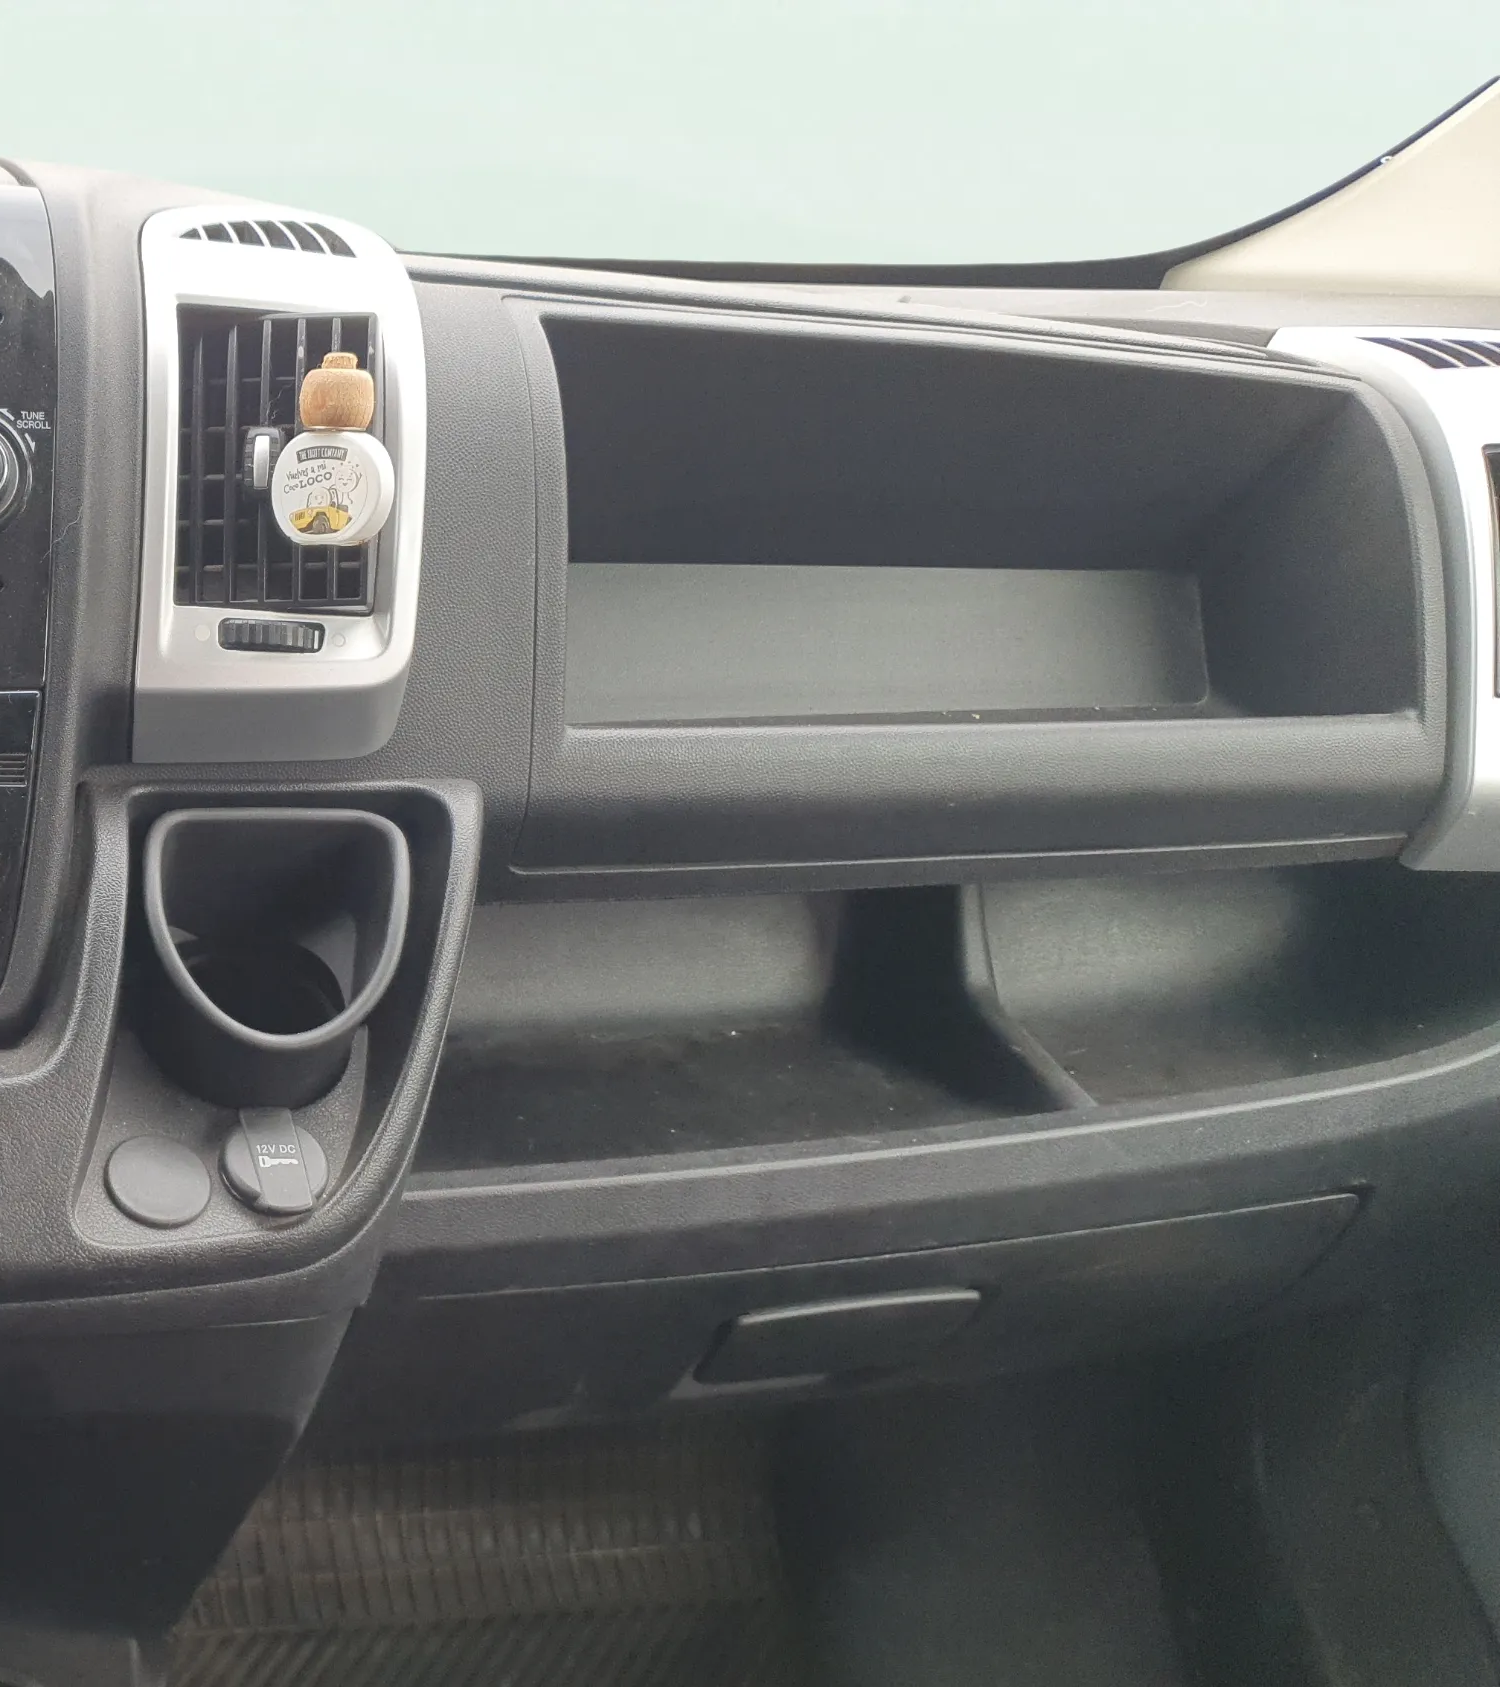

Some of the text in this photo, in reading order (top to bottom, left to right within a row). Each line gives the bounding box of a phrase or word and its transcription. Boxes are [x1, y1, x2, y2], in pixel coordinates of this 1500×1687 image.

[21, 410, 45, 420] TUNE
[16, 420, 51, 429] SCROLL
[299, 471, 333, 489] LOCO
[256, 1144, 297, 1154] 12V DC
